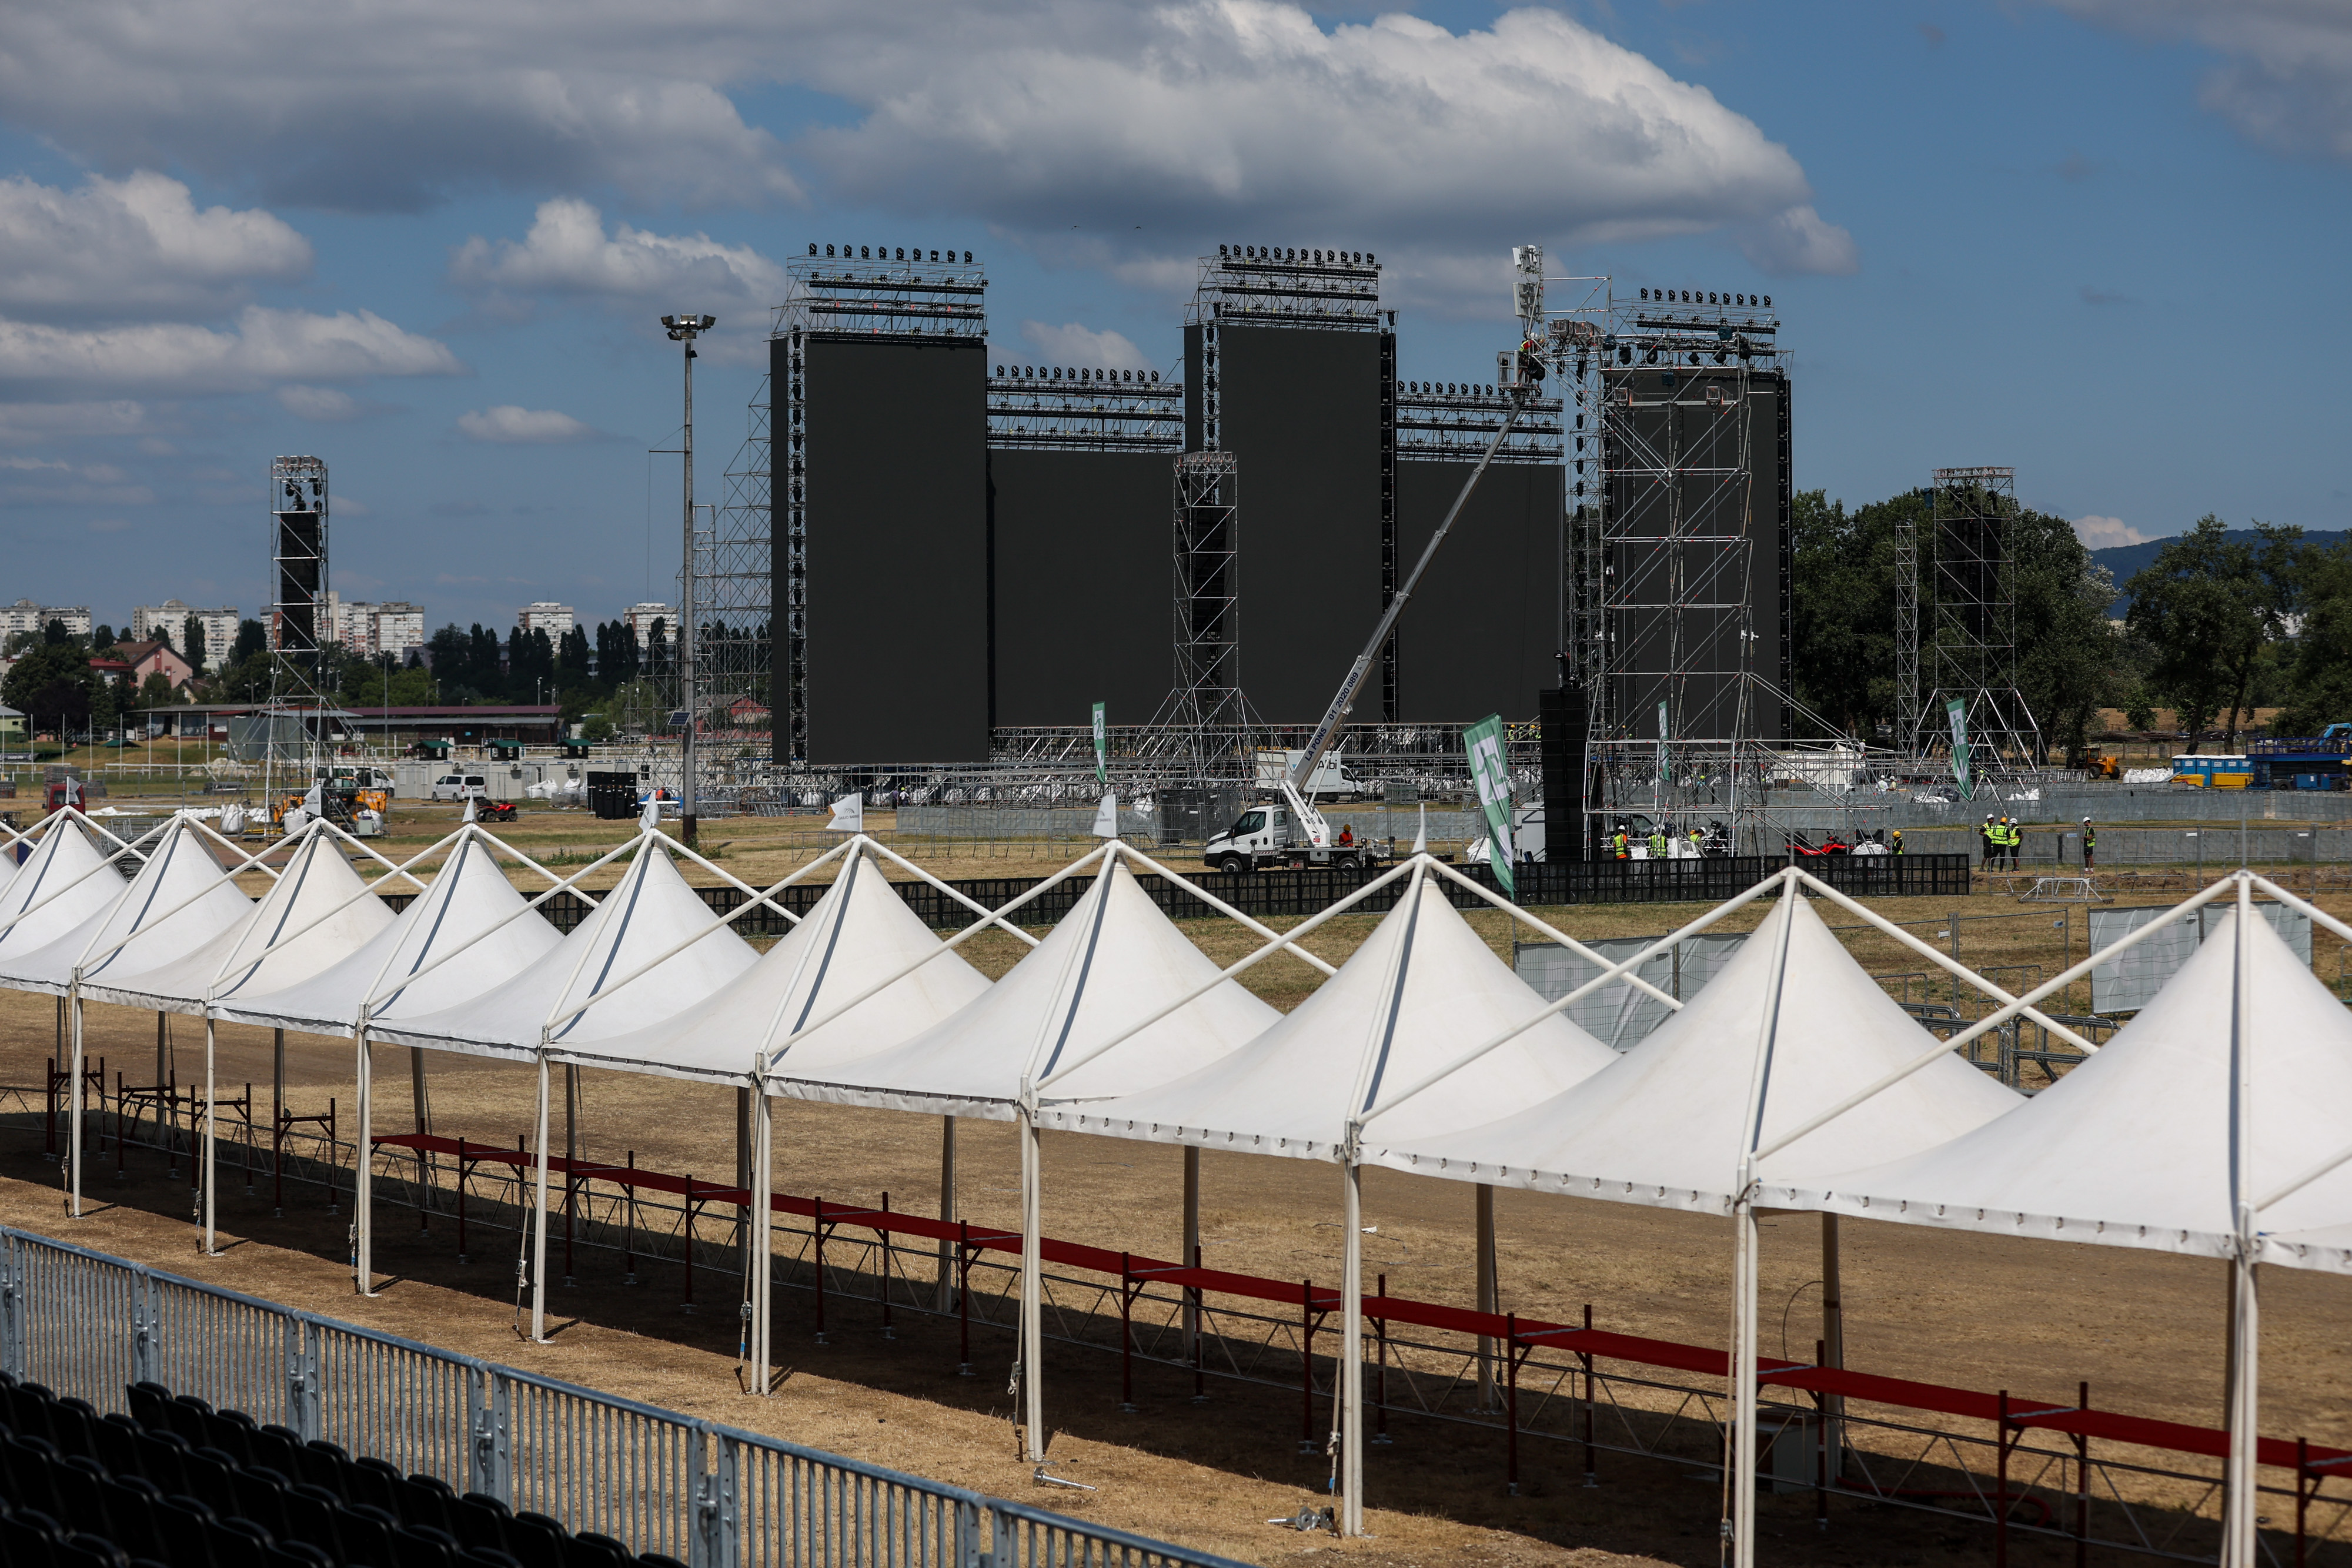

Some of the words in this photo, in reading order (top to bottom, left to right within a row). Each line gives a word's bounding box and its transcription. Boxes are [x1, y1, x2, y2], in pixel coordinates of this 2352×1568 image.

[1305, 751, 1315, 761] LA
[1312, 727, 1327, 750] PONS
[1328, 687, 1349, 720] 01/2020
[1347, 672, 1358, 687] 089
[1317, 759, 1337, 770] Abi
